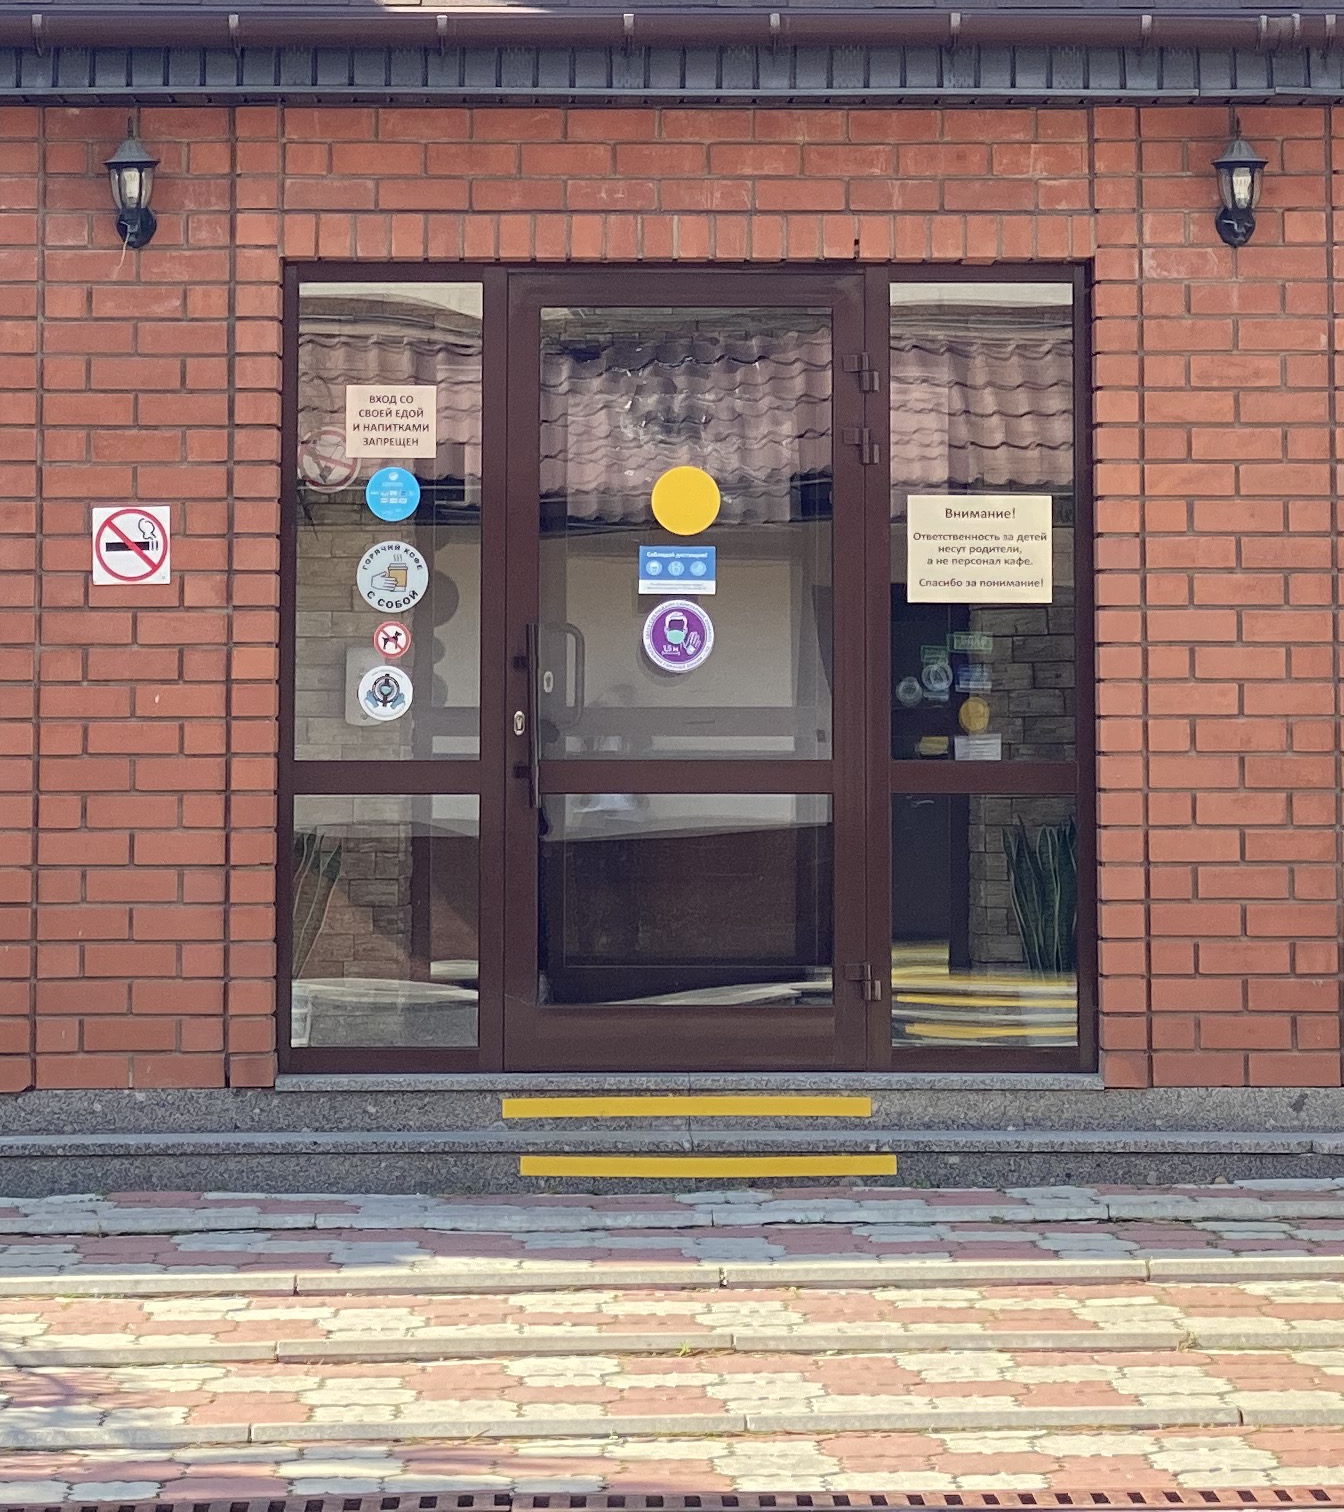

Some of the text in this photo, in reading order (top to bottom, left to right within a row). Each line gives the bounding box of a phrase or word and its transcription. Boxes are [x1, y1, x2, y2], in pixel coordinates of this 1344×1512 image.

[369, 395, 414, 405] ВХОД СО
[358, 408, 424, 419] СВОЕЙ ЕДОЙ
[352, 423, 430, 433] И НАПИТКАМИ
[362, 437, 419, 448] ЗАПРЕЩЕН
[944, 507, 1016, 520] Внимание!
[912, 532, 1001, 542] Ответственность
[1016, 532, 1047, 543] детей
[938, 545, 1023, 555] несут родители,
[362, 544, 424, 571] ГОРЯЧИЙ КОФЕ
[951, 558, 1001, 567] персонал
[918, 578, 963, 588] Спасибо
[979, 578, 1044, 587] понимание!
[367, 589, 420, 609] С СОБОЙ
